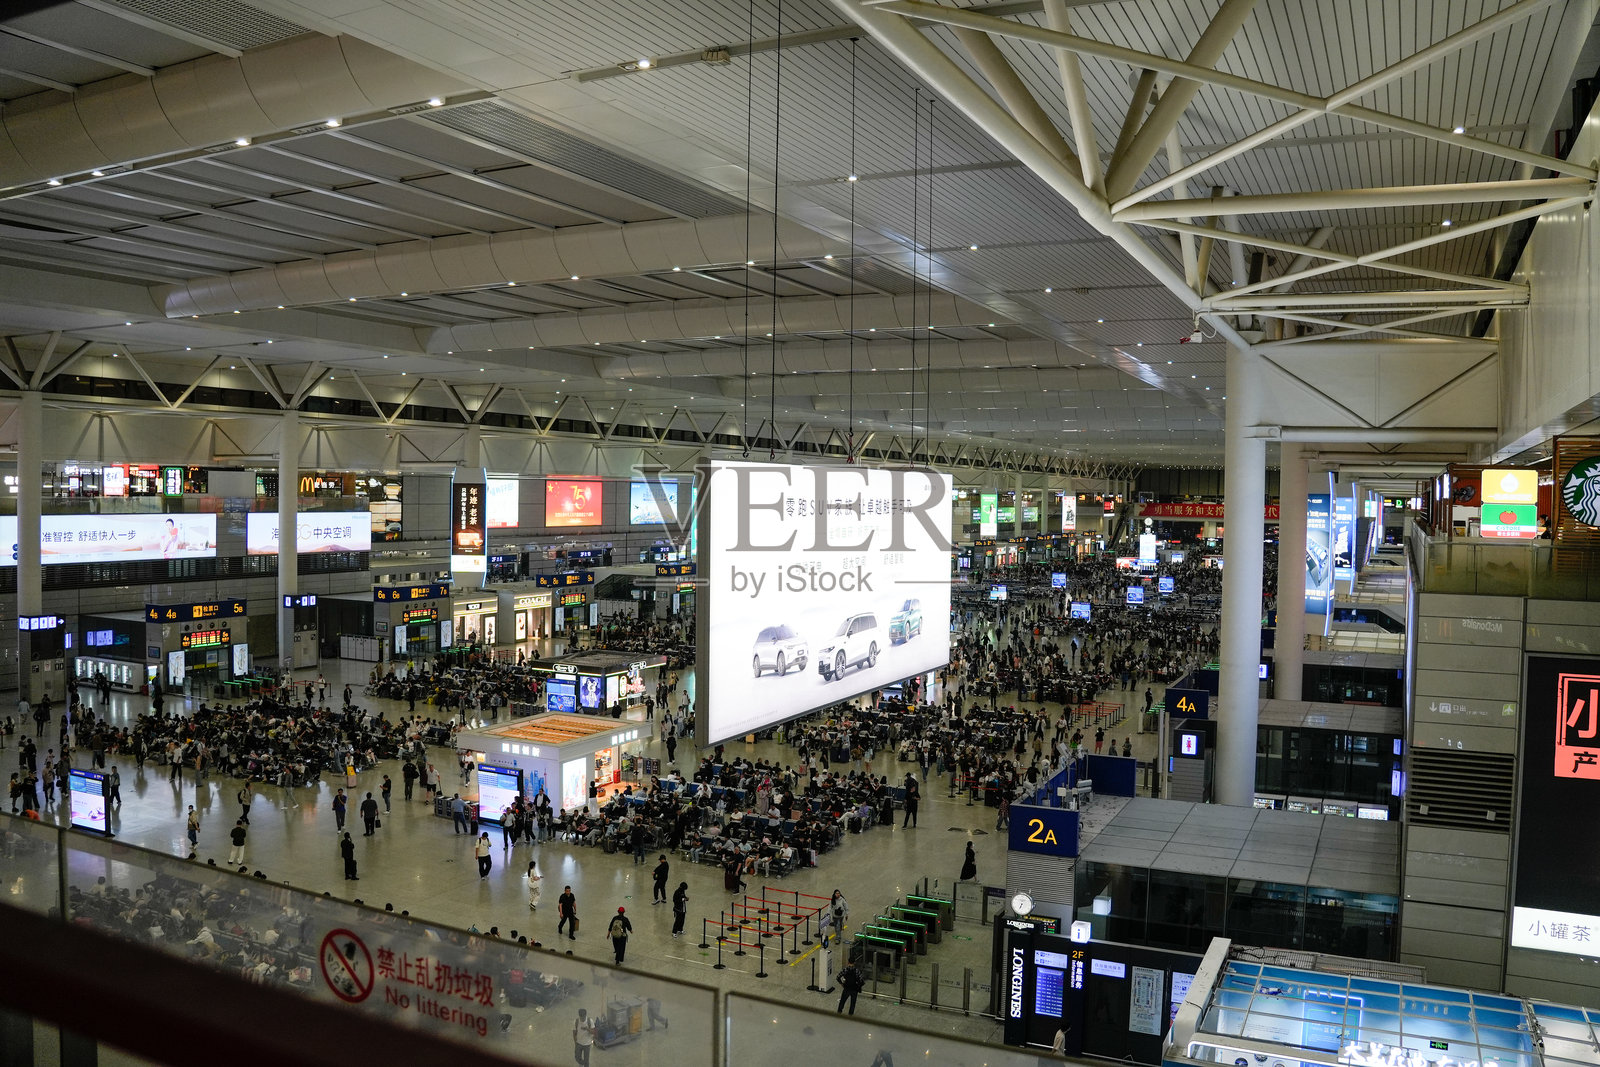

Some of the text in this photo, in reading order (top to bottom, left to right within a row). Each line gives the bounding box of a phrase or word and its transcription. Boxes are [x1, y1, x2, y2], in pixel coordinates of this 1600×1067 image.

[42, 530, 136, 543] 准智控 舒适快人一步
[377, 590, 386, 599] 6B
[392, 590, 400, 599] 6B
[519, 596, 547, 605] COACH
[149, 608, 158, 619] 4B
[166, 608, 177, 619] 4B
[233, 603, 243, 614] 5B
[1176, 696, 1196, 712] 4A
[1027, 818, 1057, 845] 2A
[1528, 919, 1591, 942] 小罐茶
[1072, 950, 1085, 959] 2F
[377, 945, 494, 1008] 禁止乱扔垃圾
[1075, 960, 1084, 989] 信息服务
[1010, 947, 1024, 1018] LONGINES
[385, 985, 488, 1036] No littering
